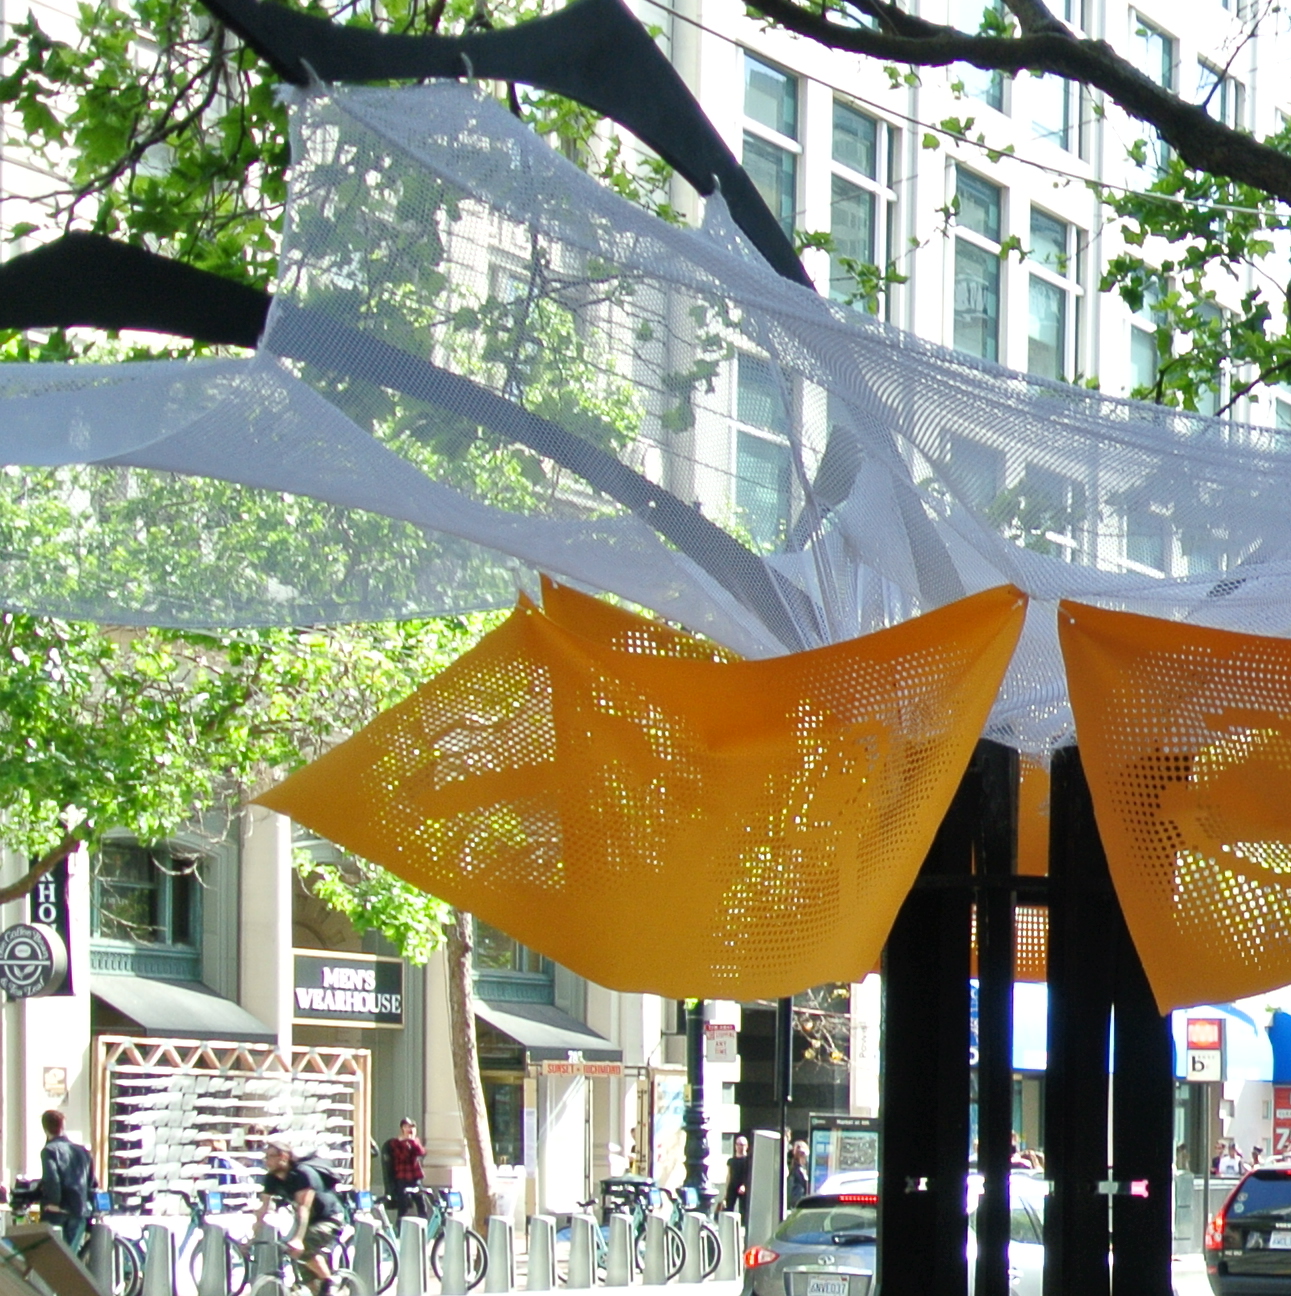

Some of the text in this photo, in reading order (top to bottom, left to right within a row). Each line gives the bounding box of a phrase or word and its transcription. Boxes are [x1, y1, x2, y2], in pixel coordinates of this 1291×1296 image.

[4, 928, 32, 942] Coffee
[25, 974, 44, 994] Leaf
[322, 966, 376, 991] MEN'S
[294, 987, 402, 1014] WEARHOUSE
[547, 1063, 574, 1074] SUNSET
